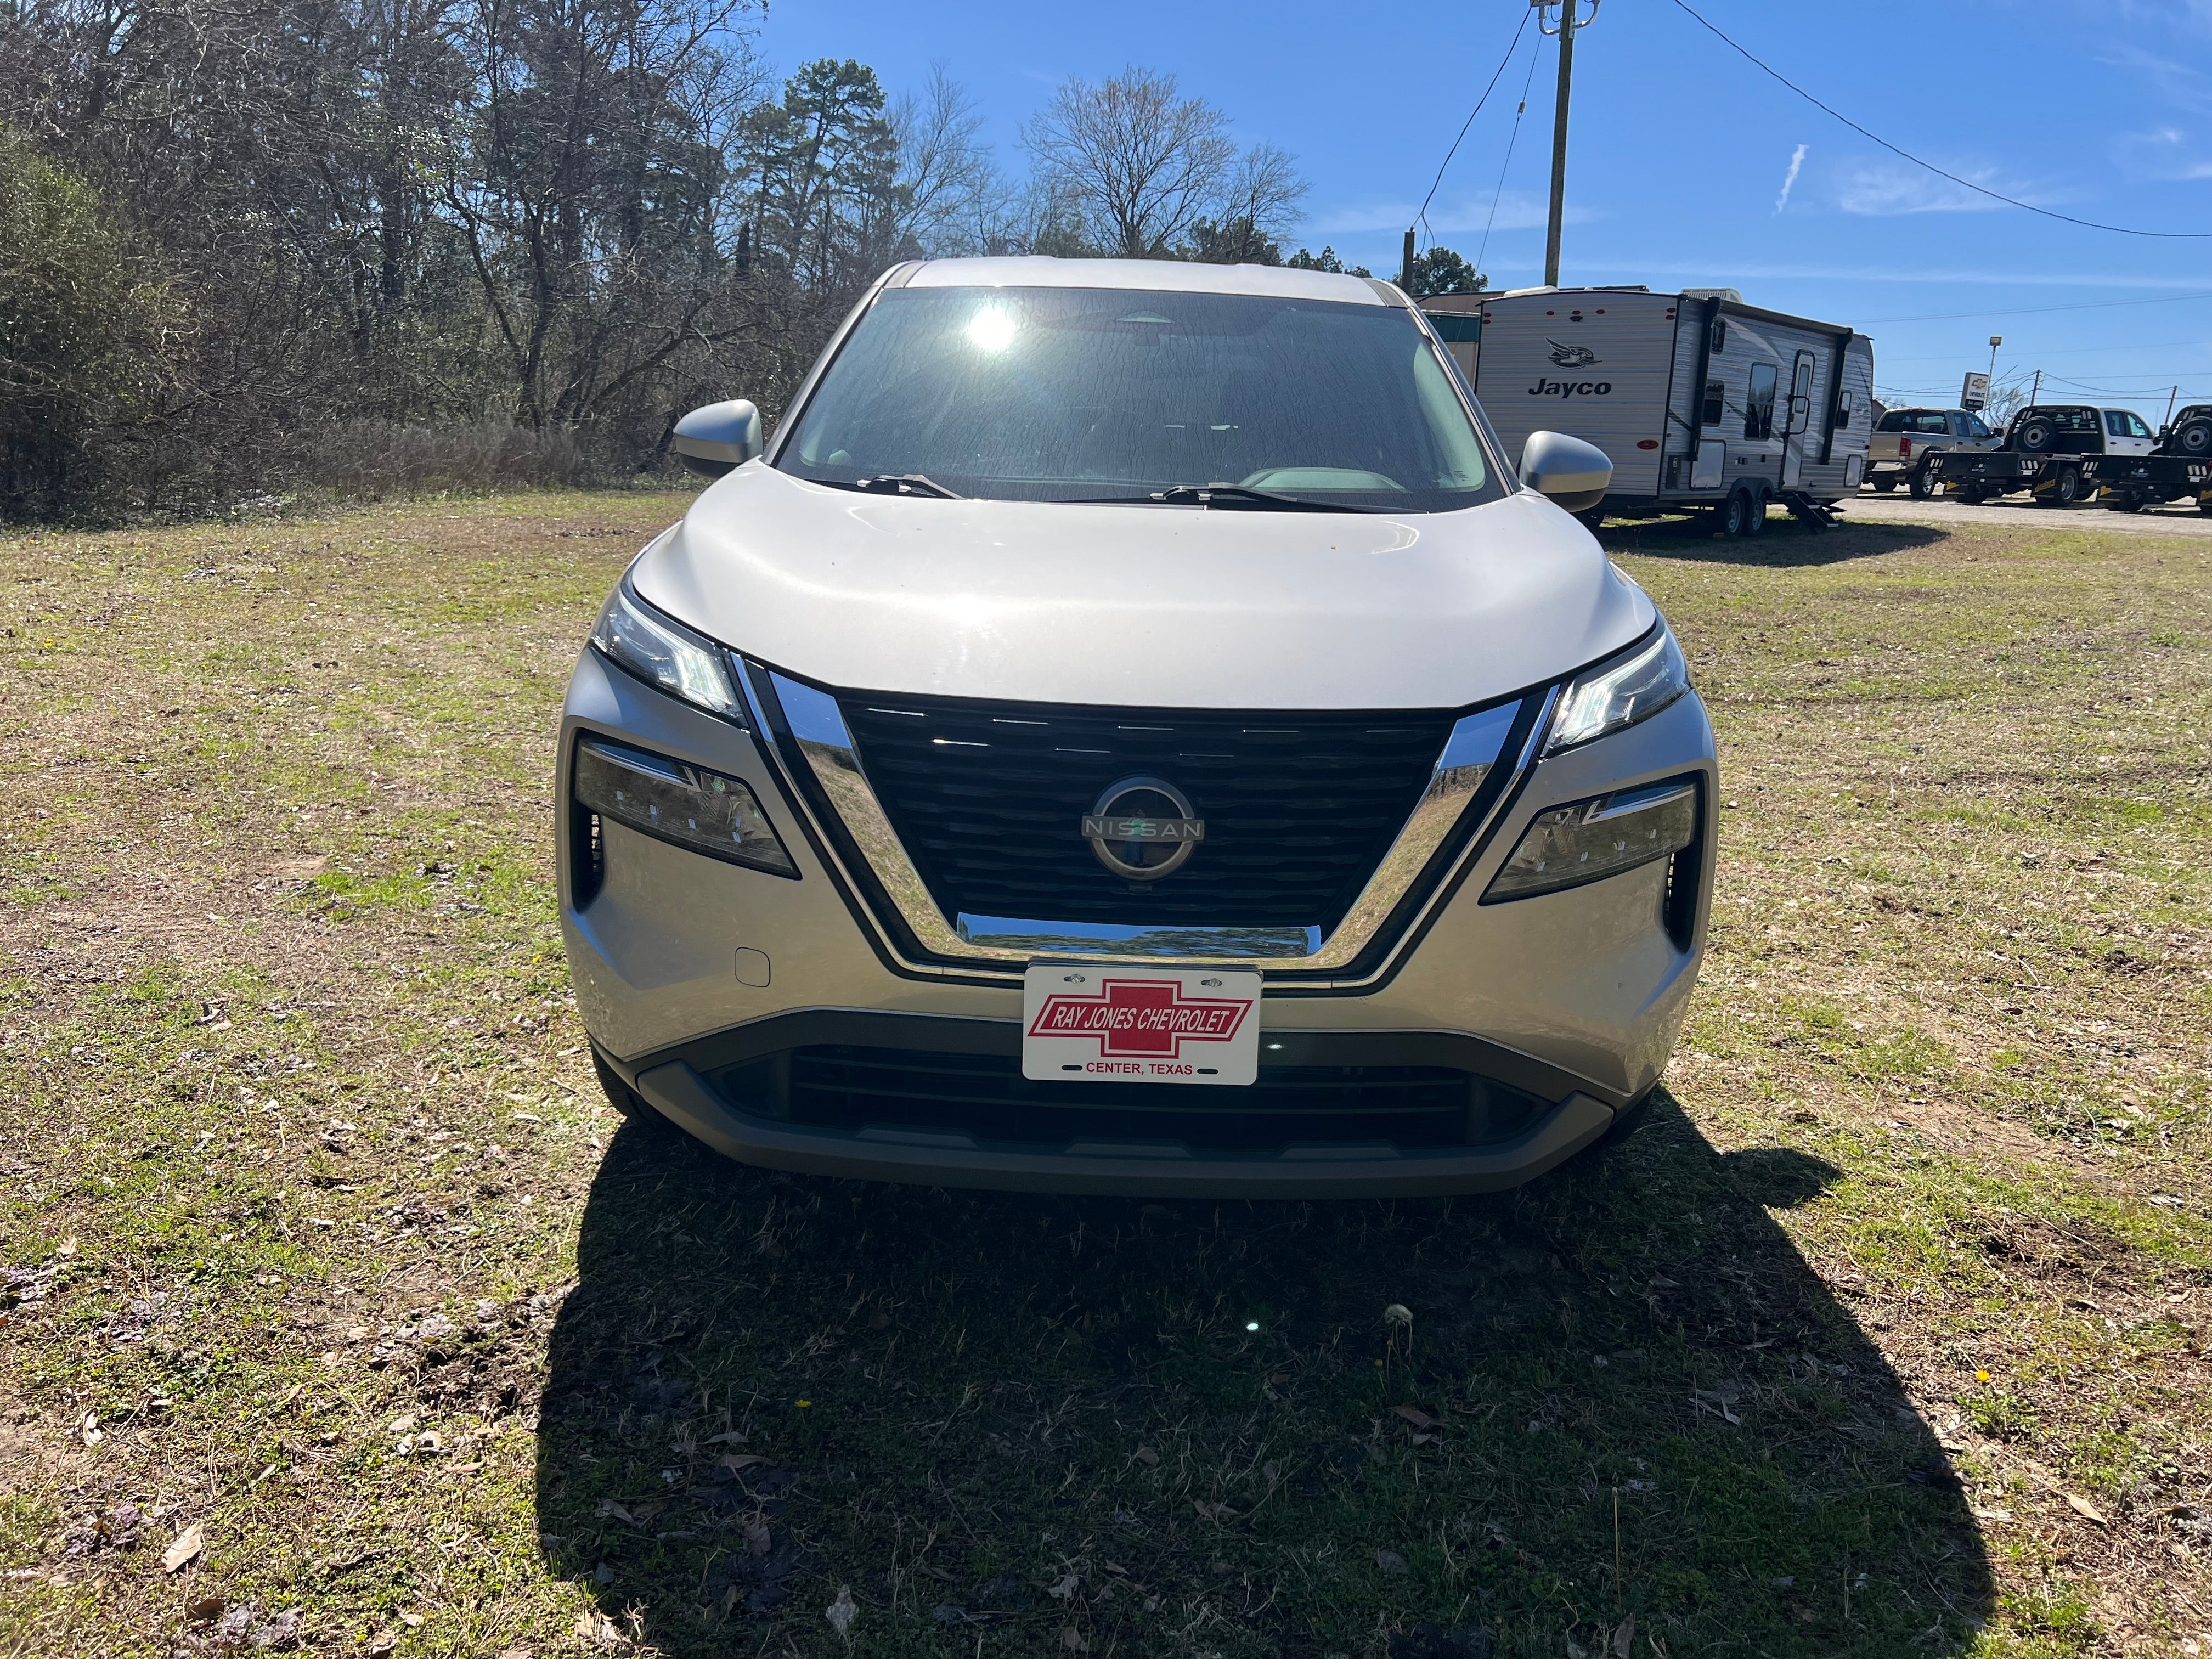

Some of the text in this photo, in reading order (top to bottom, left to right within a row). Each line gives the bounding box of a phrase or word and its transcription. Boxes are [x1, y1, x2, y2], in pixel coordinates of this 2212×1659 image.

[1528, 378, 1612, 399] Jayco
[1085, 819, 1200, 837] NISSAN
[1051, 1006, 1231, 1032] RAY JONES CHEVROLET
[1086, 1062, 1193, 1075] CENTER, TEXAS
